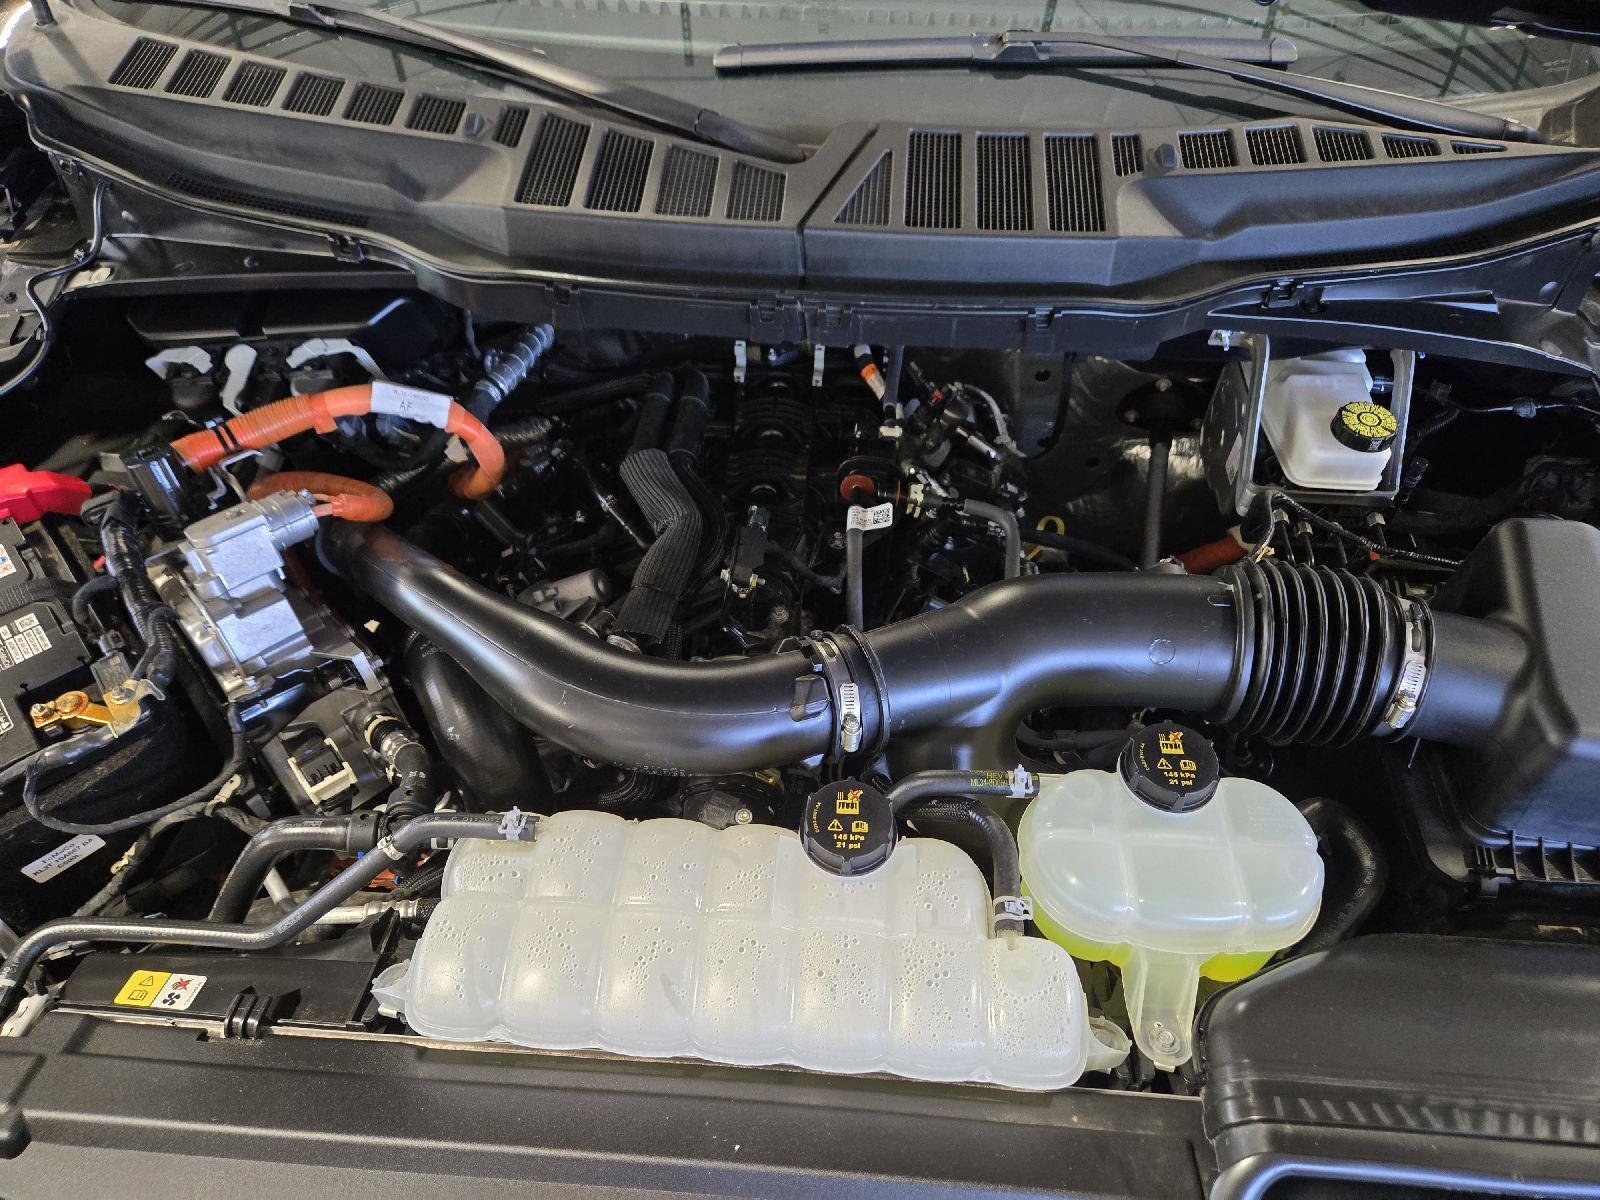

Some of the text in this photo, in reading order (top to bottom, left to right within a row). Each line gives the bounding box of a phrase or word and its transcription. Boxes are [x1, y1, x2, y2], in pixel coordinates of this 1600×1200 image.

[1180, 771, 1196, 779] kPa
[849, 833, 865, 841] kPa
[848, 842, 861, 850] psi
